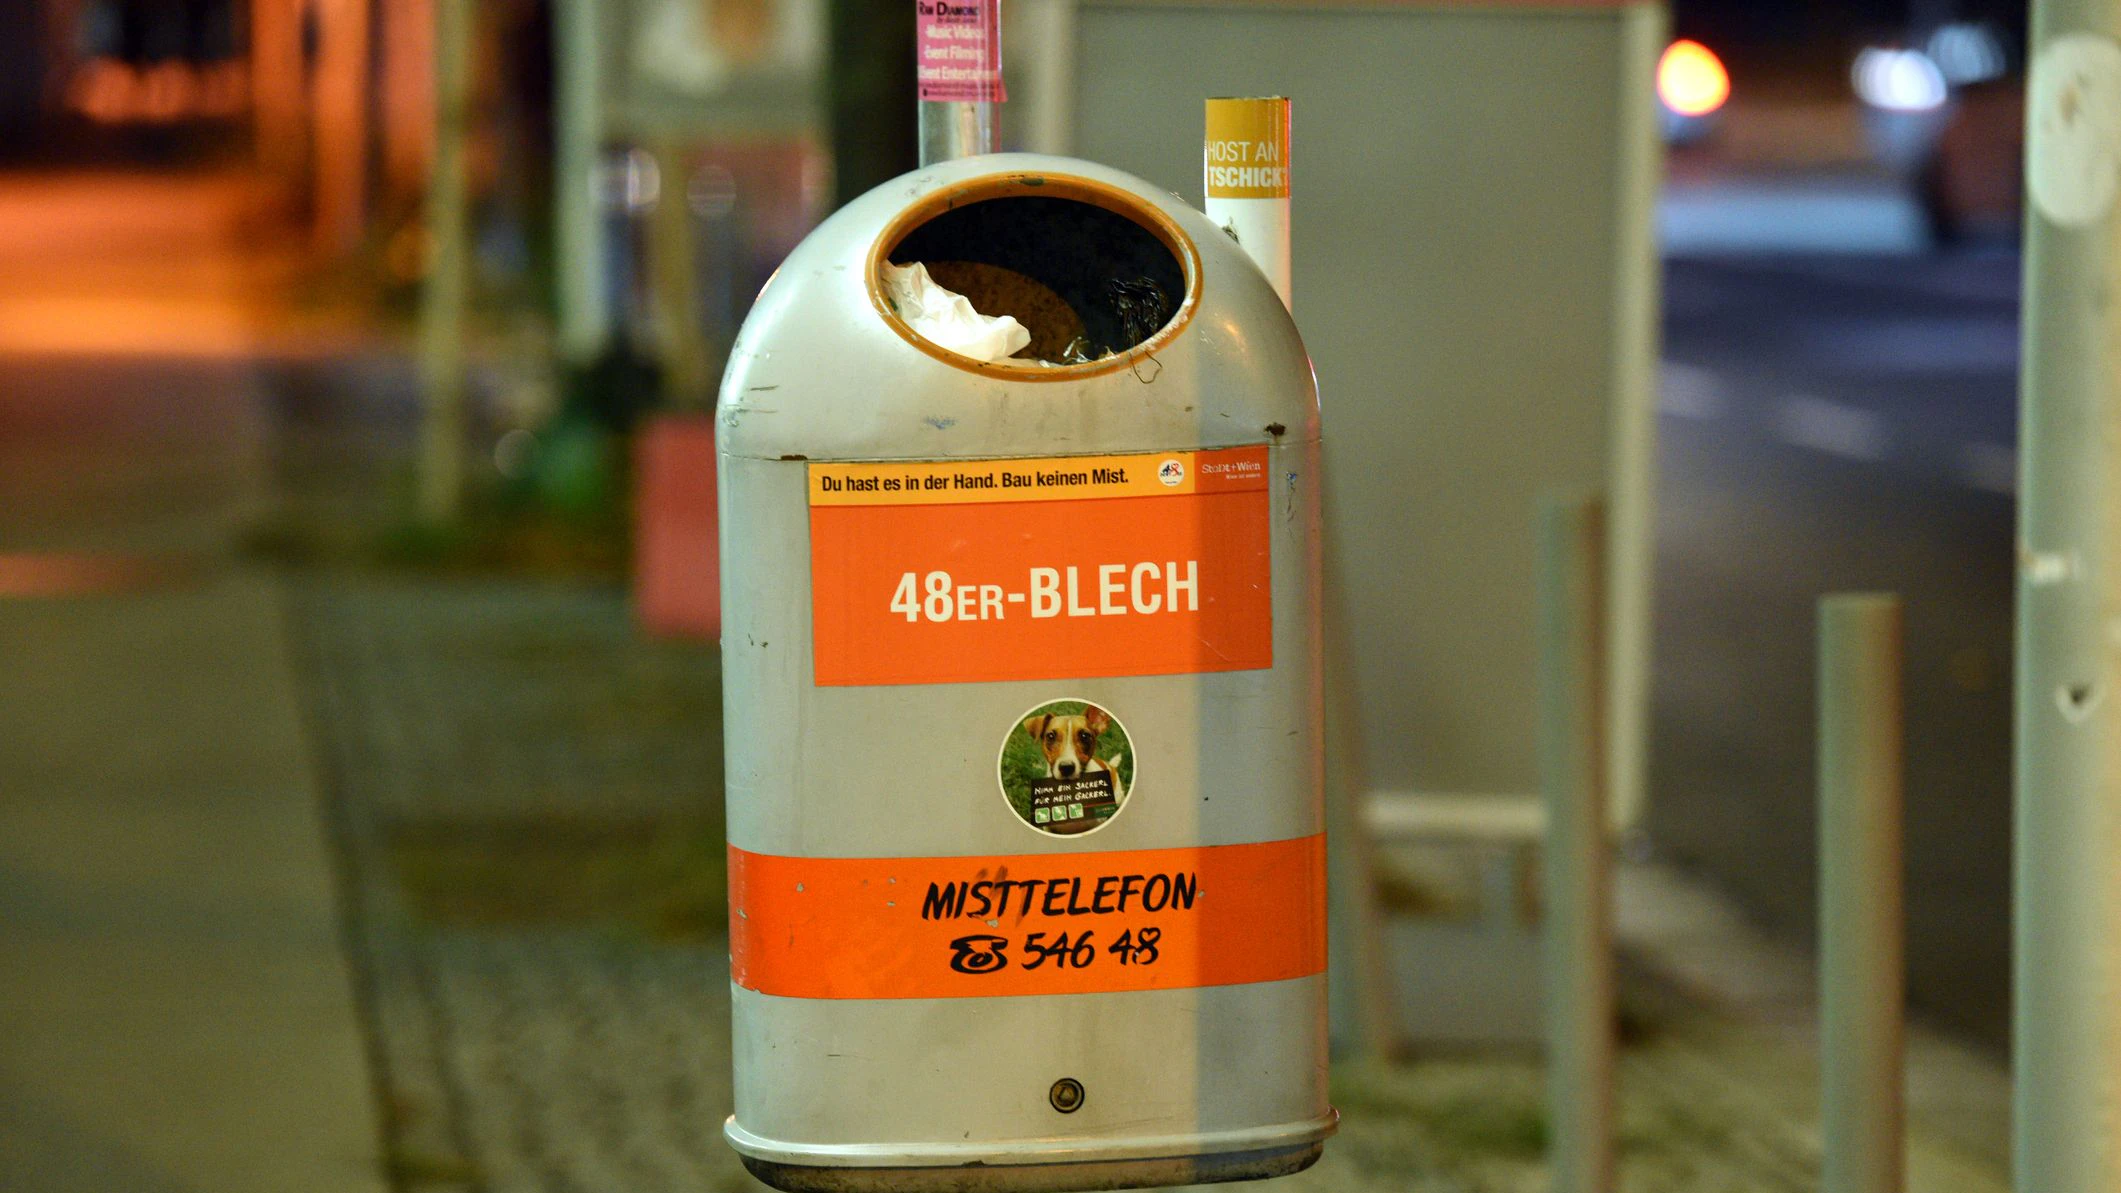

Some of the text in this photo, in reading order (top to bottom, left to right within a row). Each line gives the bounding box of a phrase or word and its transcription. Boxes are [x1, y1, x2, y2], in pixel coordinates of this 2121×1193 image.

[1207, 141, 1279, 162] HOST AN
[822, 468, 1129, 491] Du hast es in der Hand. Bau keinen Mist.
[921, 871, 1196, 921] MISTTELEFON
[1020, 927, 1161, 970] 546 48
